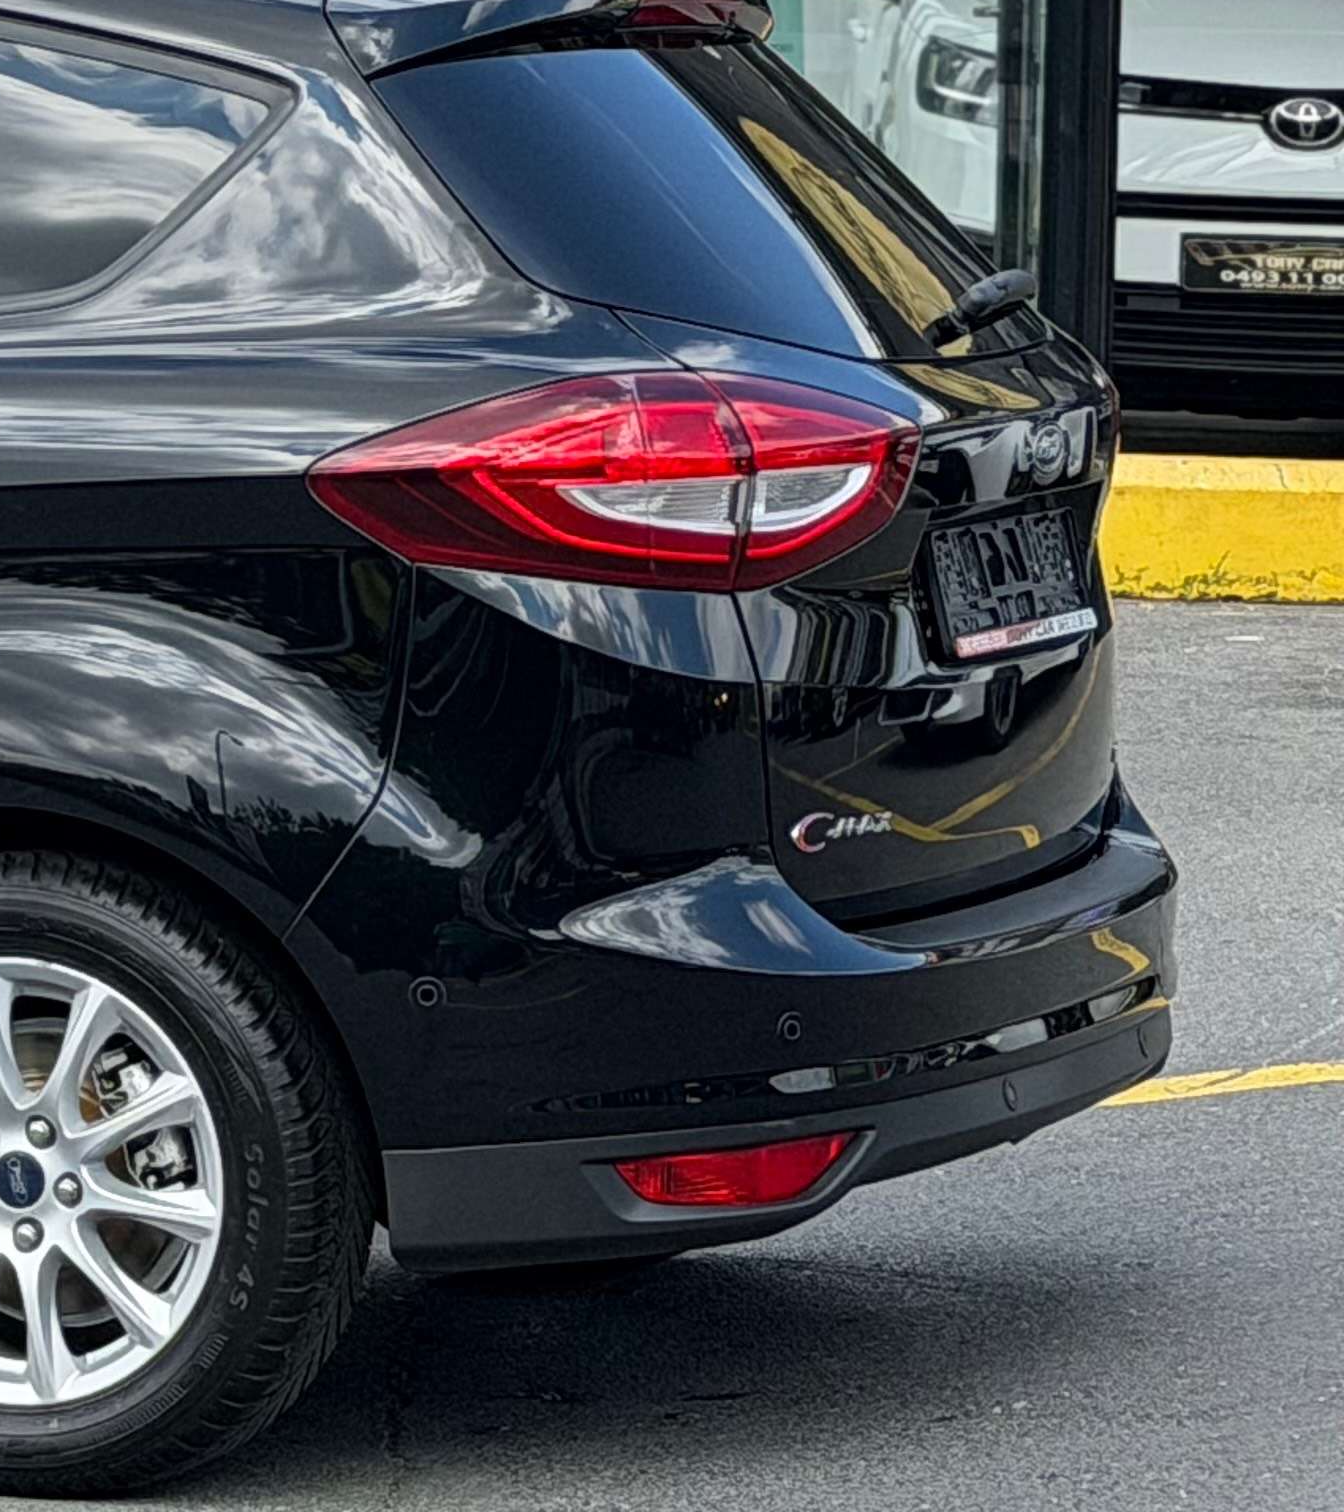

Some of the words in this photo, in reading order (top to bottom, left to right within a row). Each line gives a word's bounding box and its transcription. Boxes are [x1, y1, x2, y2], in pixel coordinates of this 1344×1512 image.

[1220, 269, 1280, 283] 0493
[1288, 271, 1313, 285] 11
[243, 1143, 270, 1252] Solar
[228, 1263, 255, 1312] 4S
